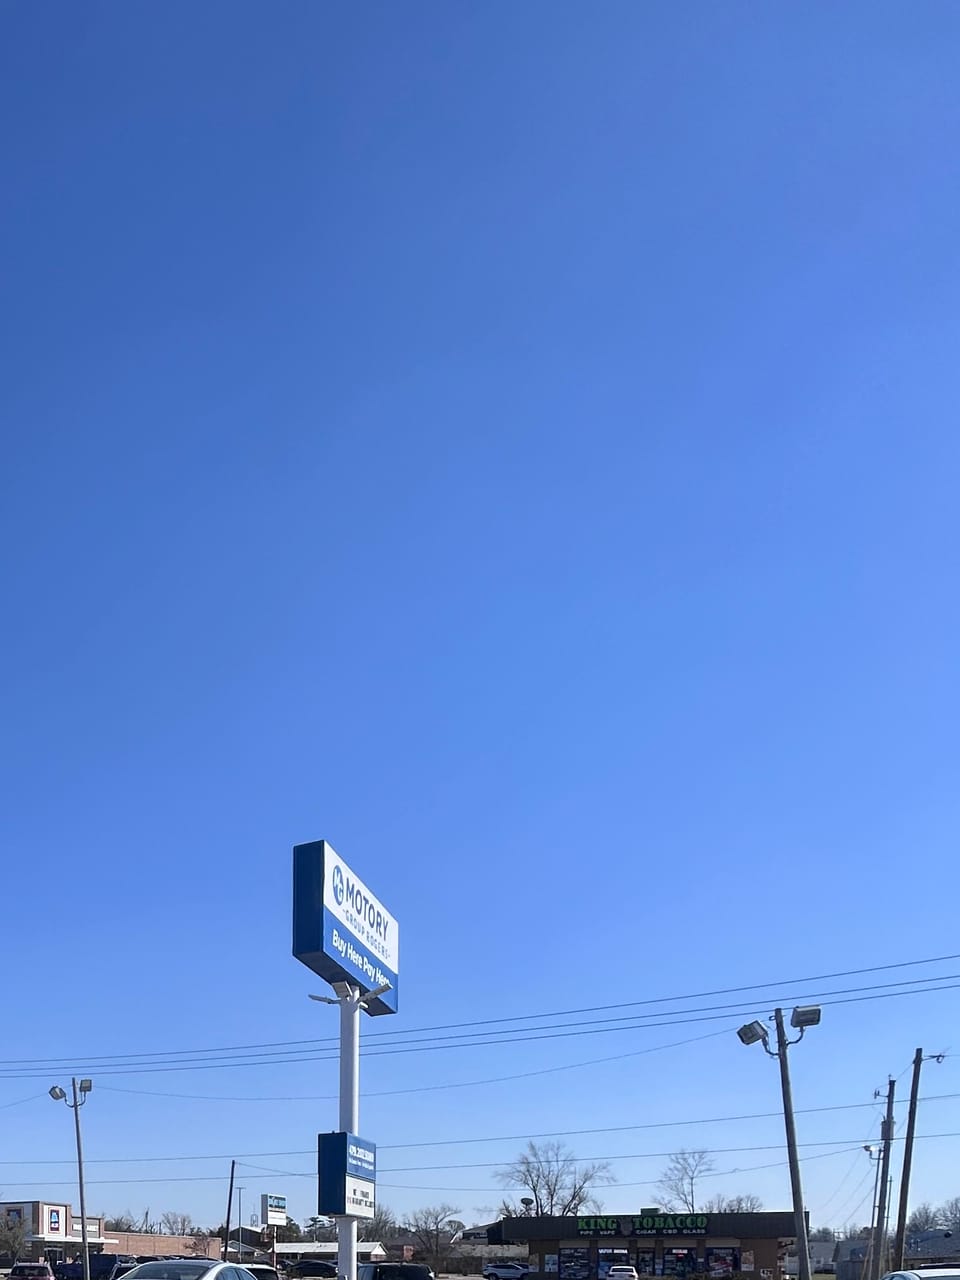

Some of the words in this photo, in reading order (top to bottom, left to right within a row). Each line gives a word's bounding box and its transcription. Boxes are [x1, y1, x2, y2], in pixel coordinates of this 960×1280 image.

[346, 877, 388, 941] MOTORY
[332, 928, 347, 958] Buy
[347, 942, 363, 969] Here
[363, 956, 376, 982] Pay
[577, 1218, 617, 1230] KING
[632, 1216, 708, 1229] TOBACCO
